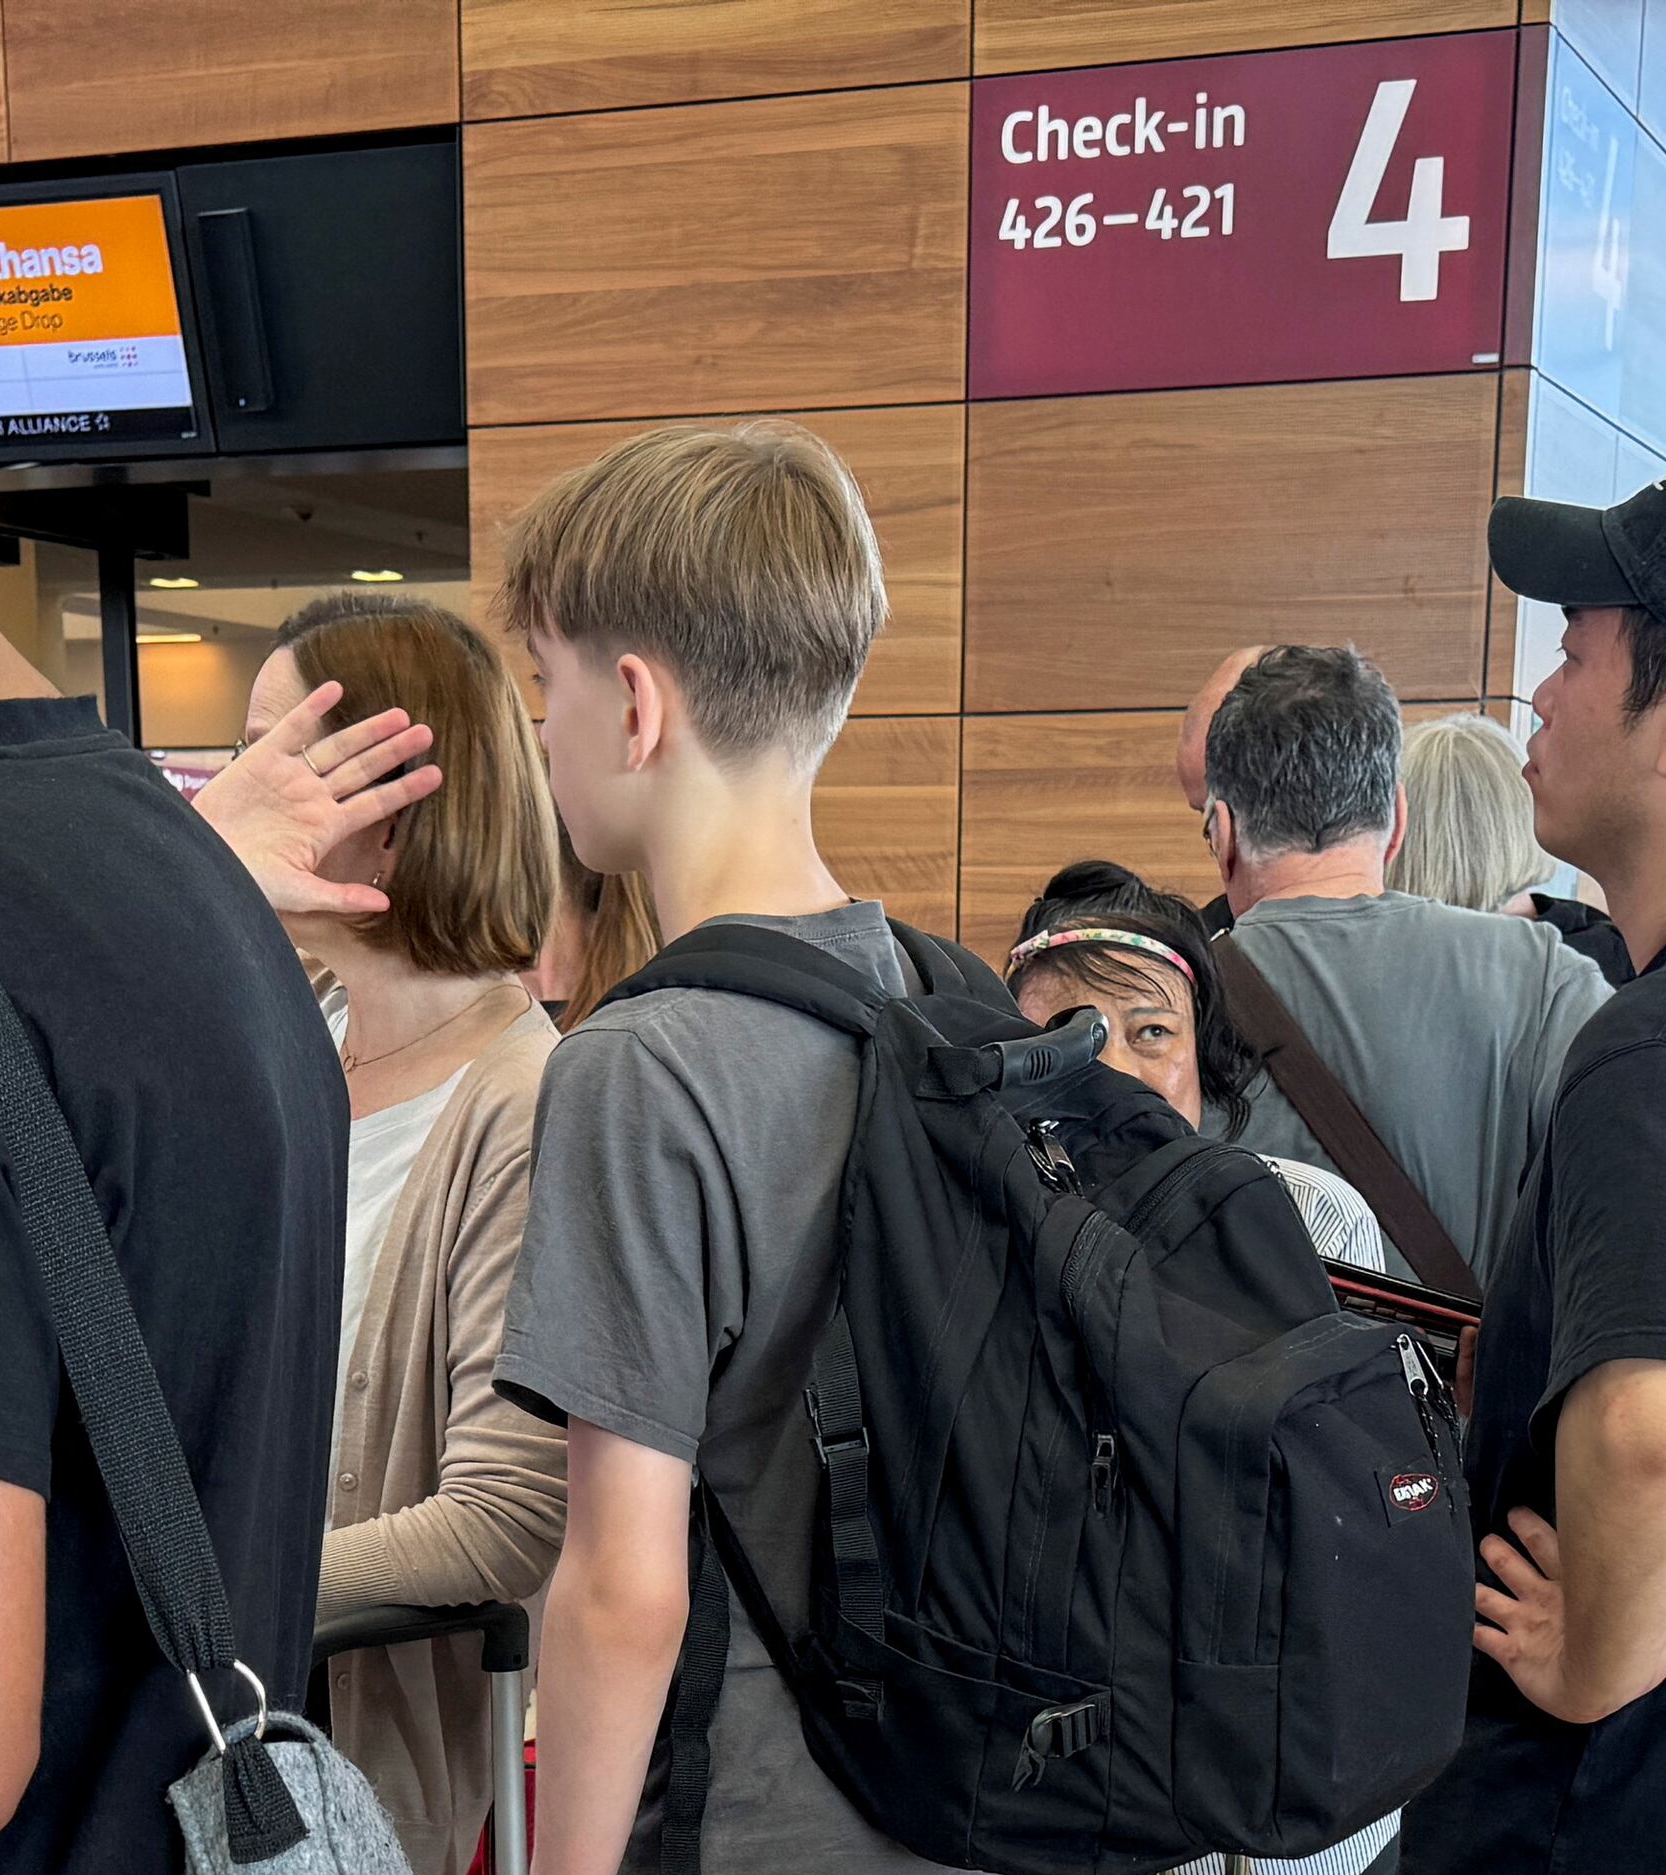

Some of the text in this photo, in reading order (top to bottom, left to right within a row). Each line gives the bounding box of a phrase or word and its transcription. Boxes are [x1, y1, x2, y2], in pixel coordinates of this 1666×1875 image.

[1001, 91, 1245, 165] Check-in
[998, 182, 1235, 251] 426–421
[1326, 78, 1470, 302] 4
[19, 310, 64, 334] Drop
[7, 414, 92, 438] ALLIANCE
